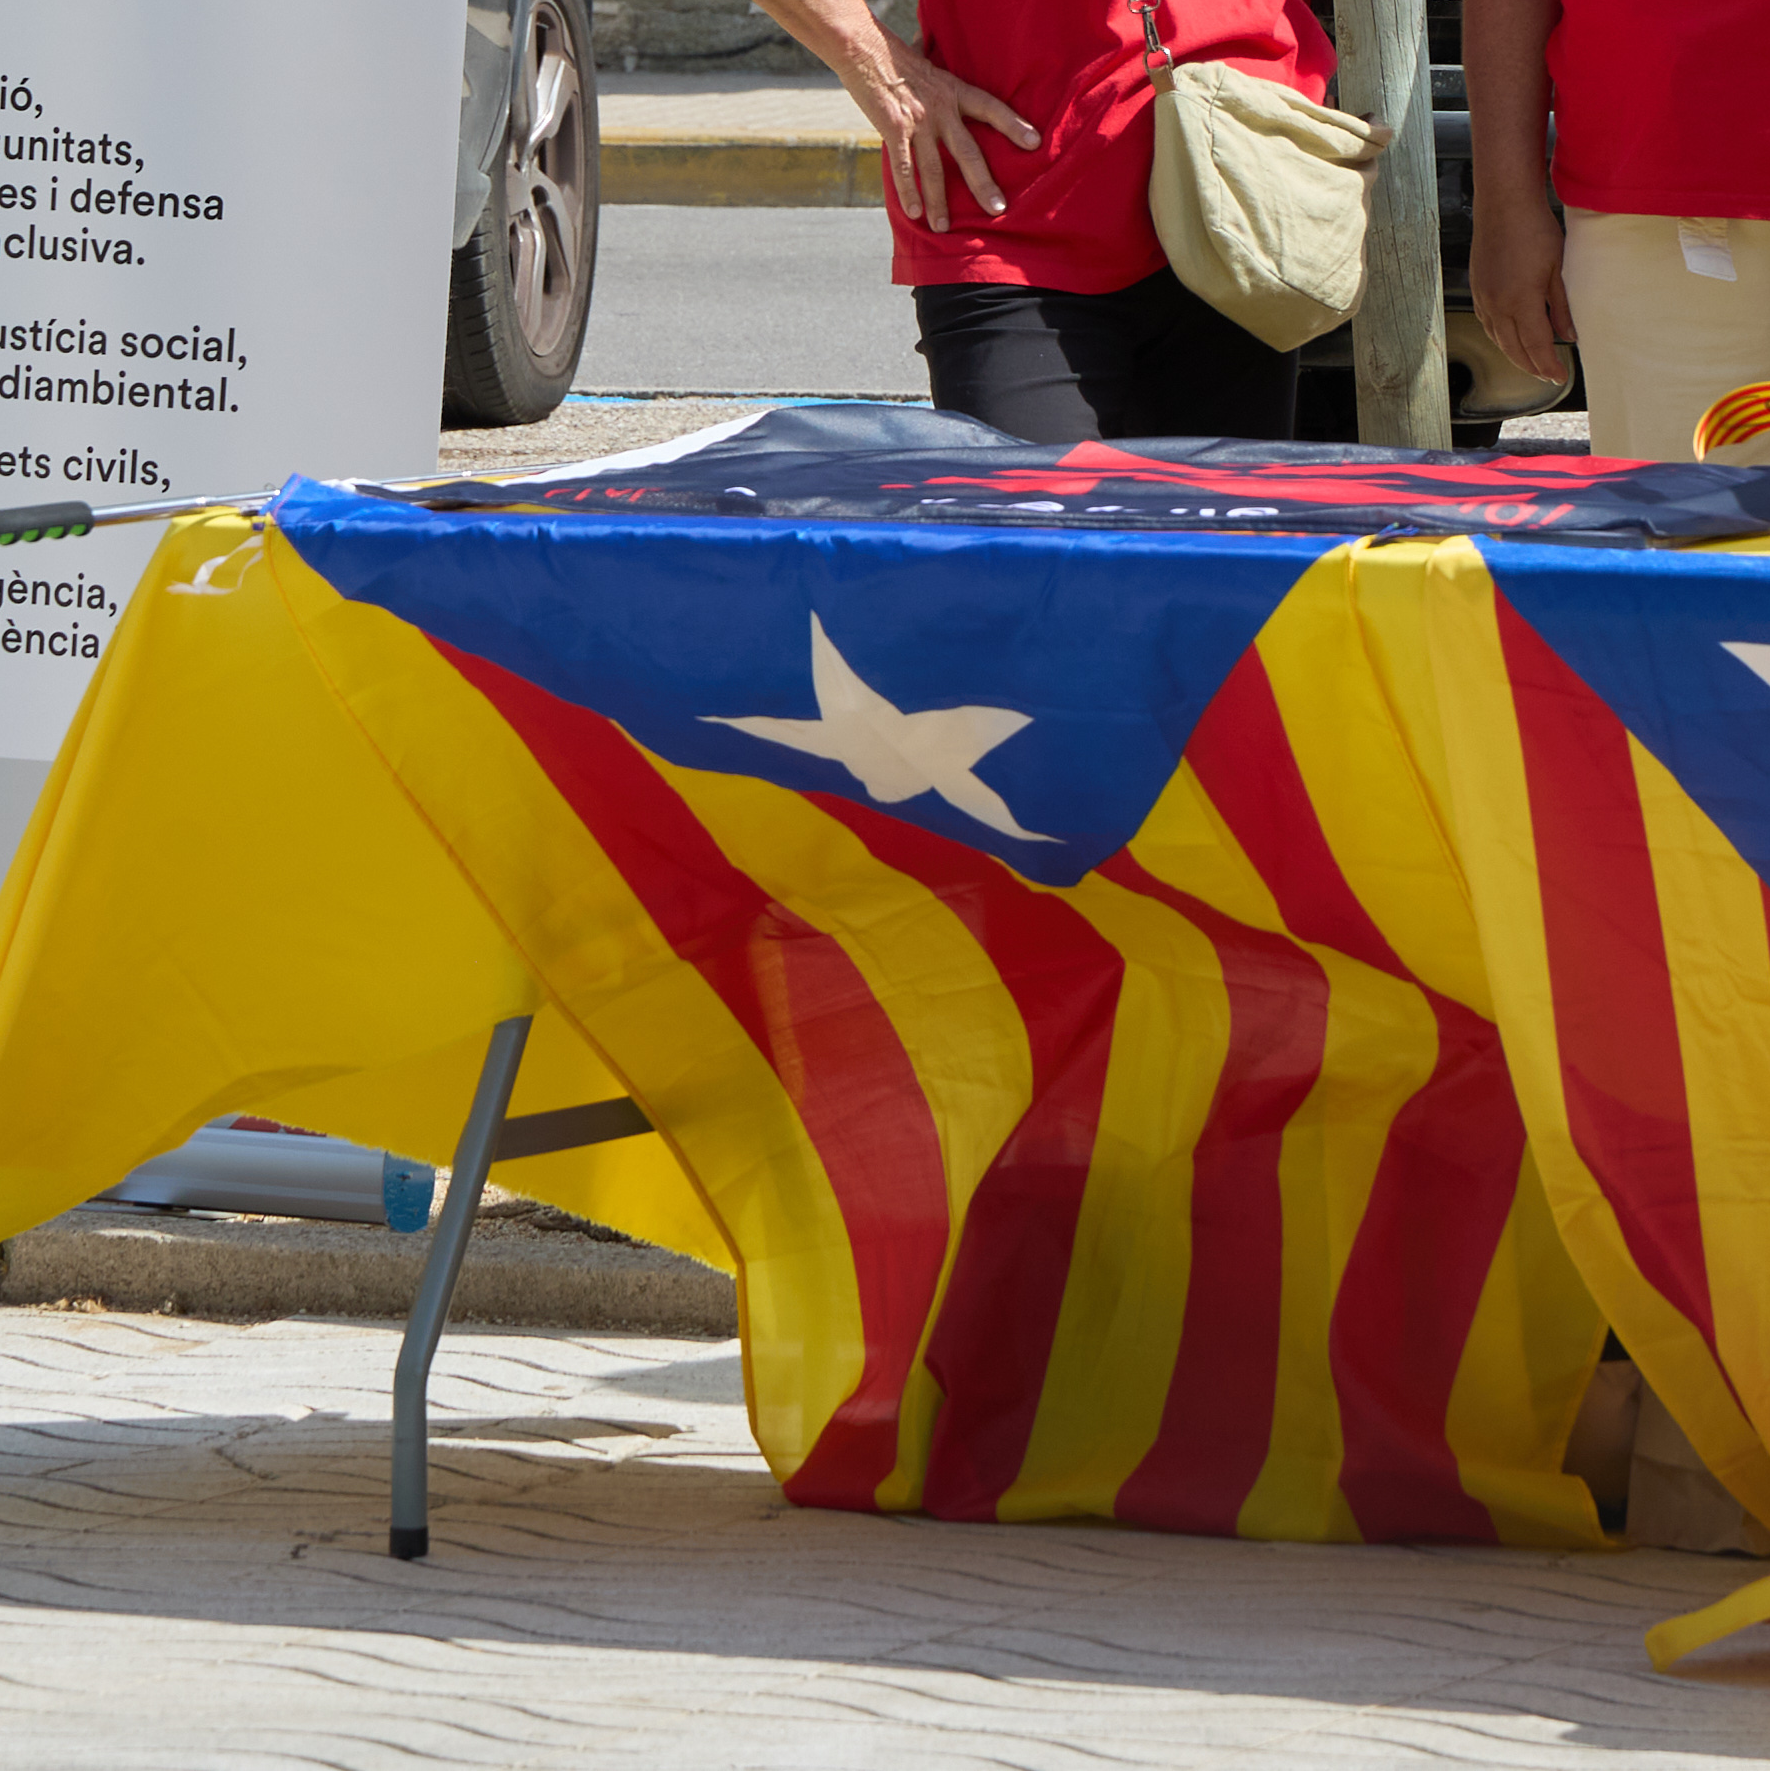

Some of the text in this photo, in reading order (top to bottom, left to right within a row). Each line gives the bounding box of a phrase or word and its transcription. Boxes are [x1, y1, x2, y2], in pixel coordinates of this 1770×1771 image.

[50, 176, 57, 211] i
[70, 177, 224, 221] defensa
[120, 324, 247, 371] social,
[63, 446, 170, 494] civils,
